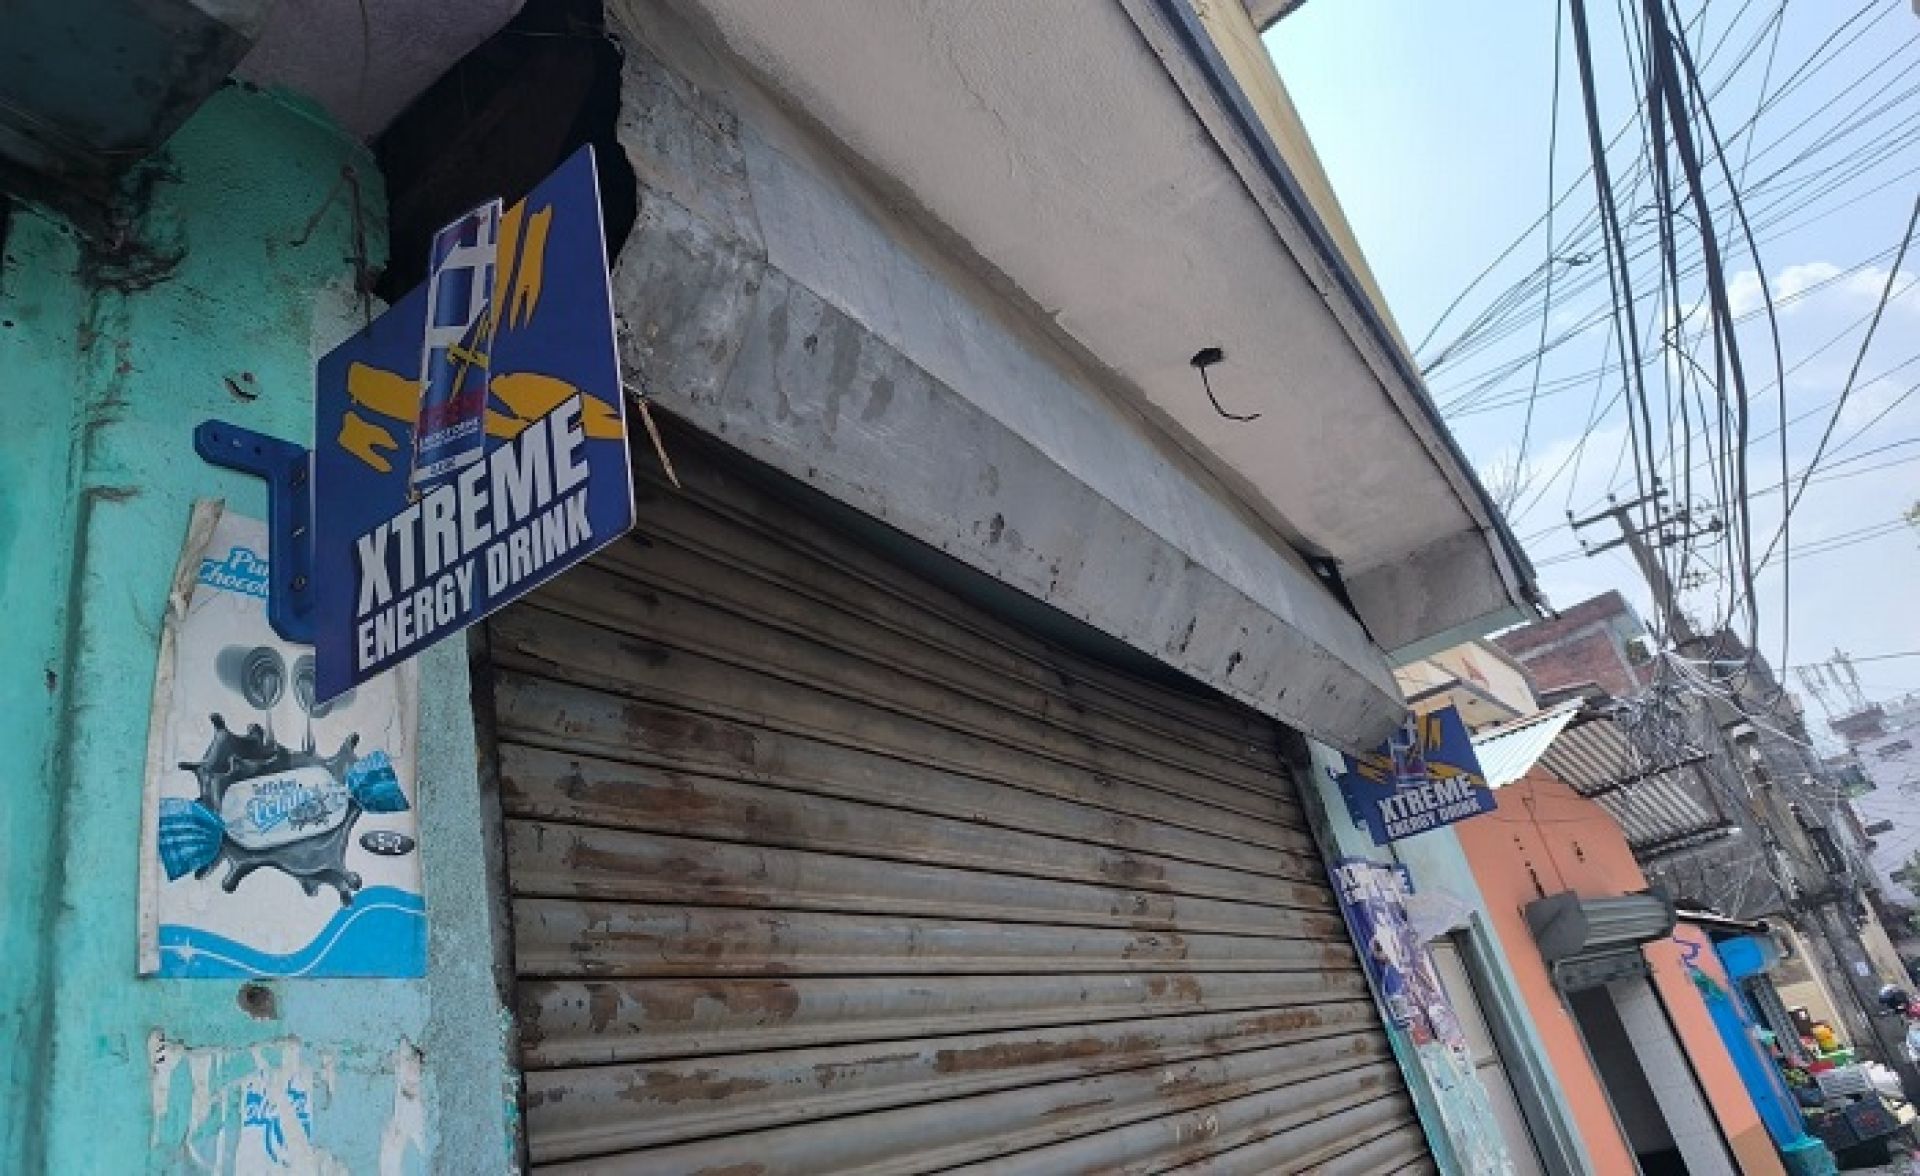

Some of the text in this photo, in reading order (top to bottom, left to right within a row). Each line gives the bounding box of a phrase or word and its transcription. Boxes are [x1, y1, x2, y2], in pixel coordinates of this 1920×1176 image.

[357, 394, 590, 618] XTREME
[358, 488, 592, 672] ENERGY DRINK
[1376, 772, 1477, 824] XTREME
